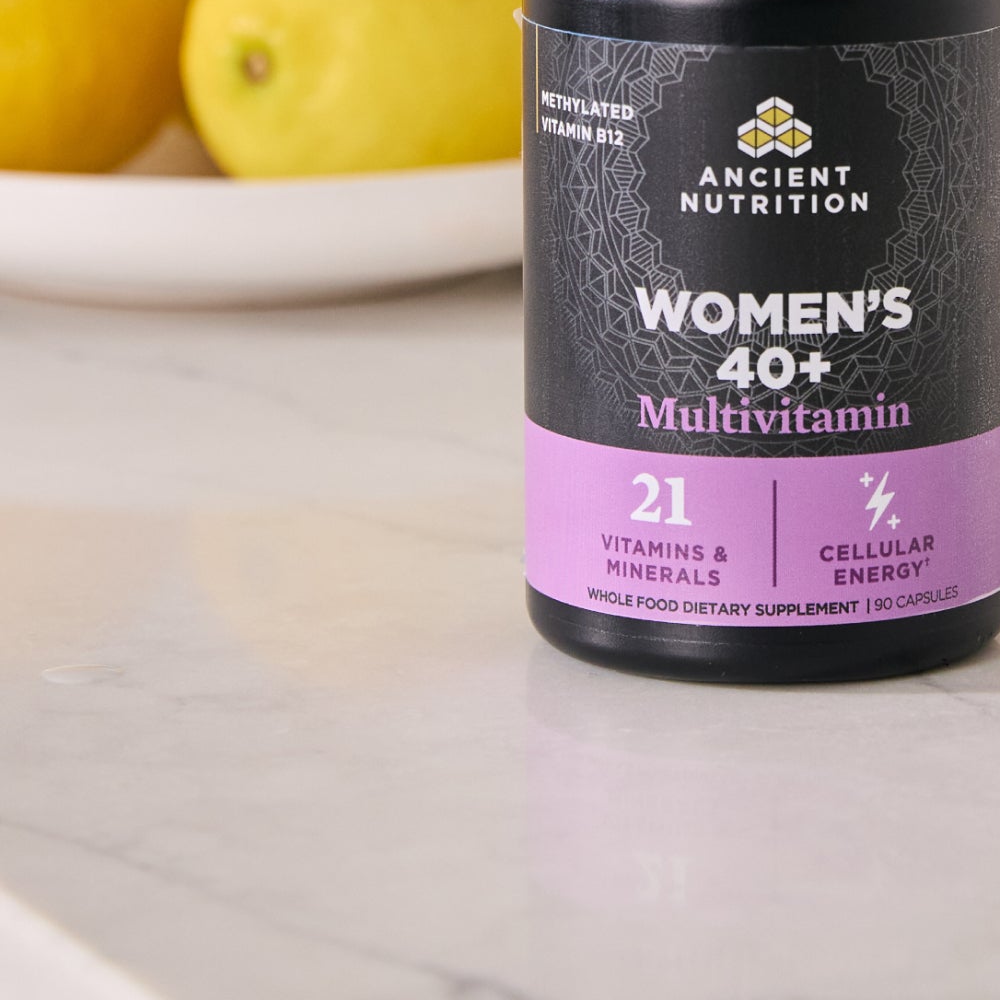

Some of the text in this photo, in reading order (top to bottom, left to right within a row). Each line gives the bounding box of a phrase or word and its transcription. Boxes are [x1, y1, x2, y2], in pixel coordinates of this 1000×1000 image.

[541, 90, 634, 121] METHYLATED
[541, 116, 624, 146] VITAMIN B12
[699, 165, 851, 187] ANCIENT
[681, 192, 868, 214] NUTRITION
[634, 286, 913, 335] WOMEN'S
[716, 346, 831, 389] 40+
[637, 392, 912, 434] Multivitamin
[630, 473, 692, 526] 21
[601, 533, 727, 562] VITAMINS &
[819, 534, 935, 562] CELLULAR
[607, 559, 721, 586] MINERALS
[587, 585, 959, 616] WHOLE FOOD DIETARY SUPPLEMENT 90 CAPSULES
